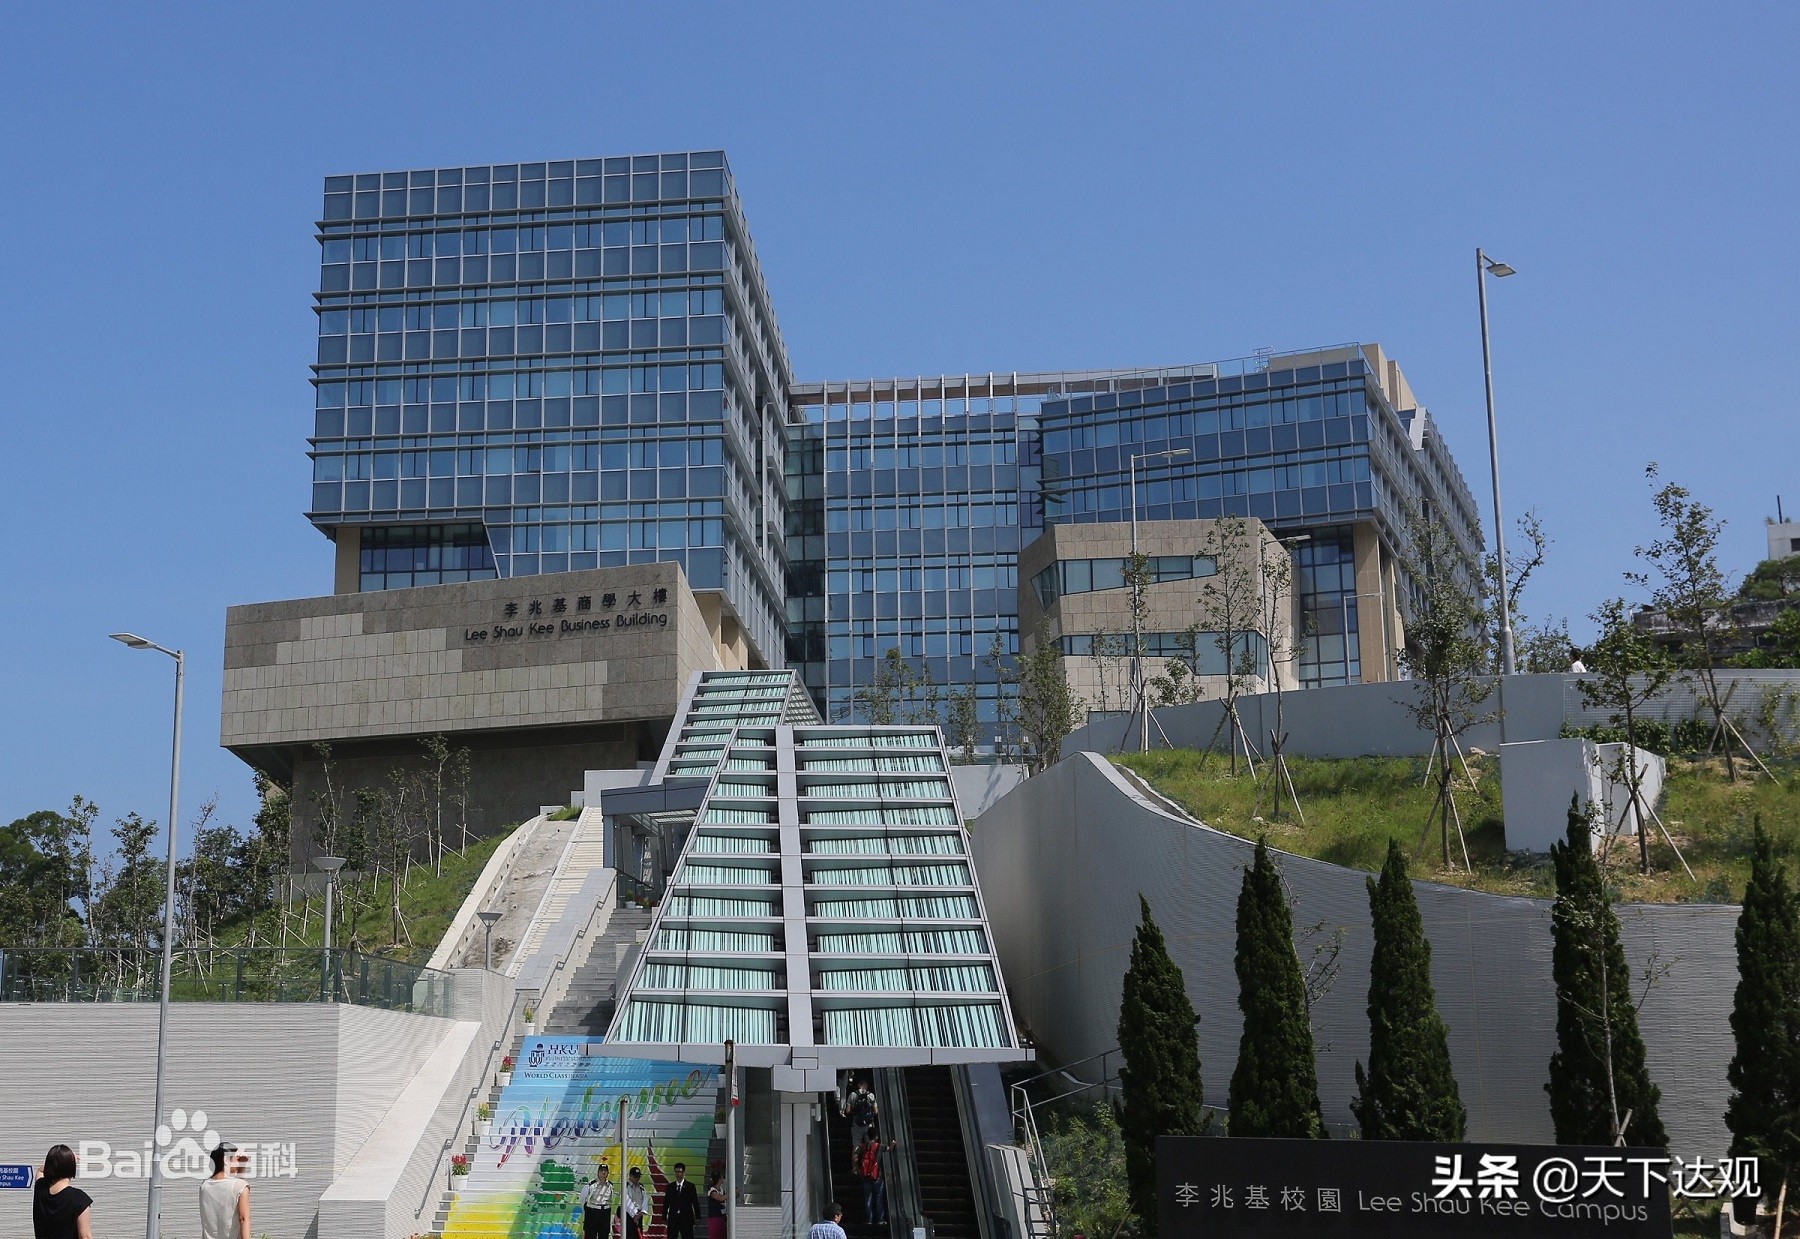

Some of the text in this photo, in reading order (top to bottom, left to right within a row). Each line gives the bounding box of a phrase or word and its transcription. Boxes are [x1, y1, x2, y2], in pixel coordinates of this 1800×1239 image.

[465, 612, 668, 641] Lee Shau Kee Business Building
[548, 1044, 579, 1055] HKU
[1175, 1182, 1341, 1213] 李兆基校園
[1358, 1190, 1648, 1226] Lee Shau Kee Campus
